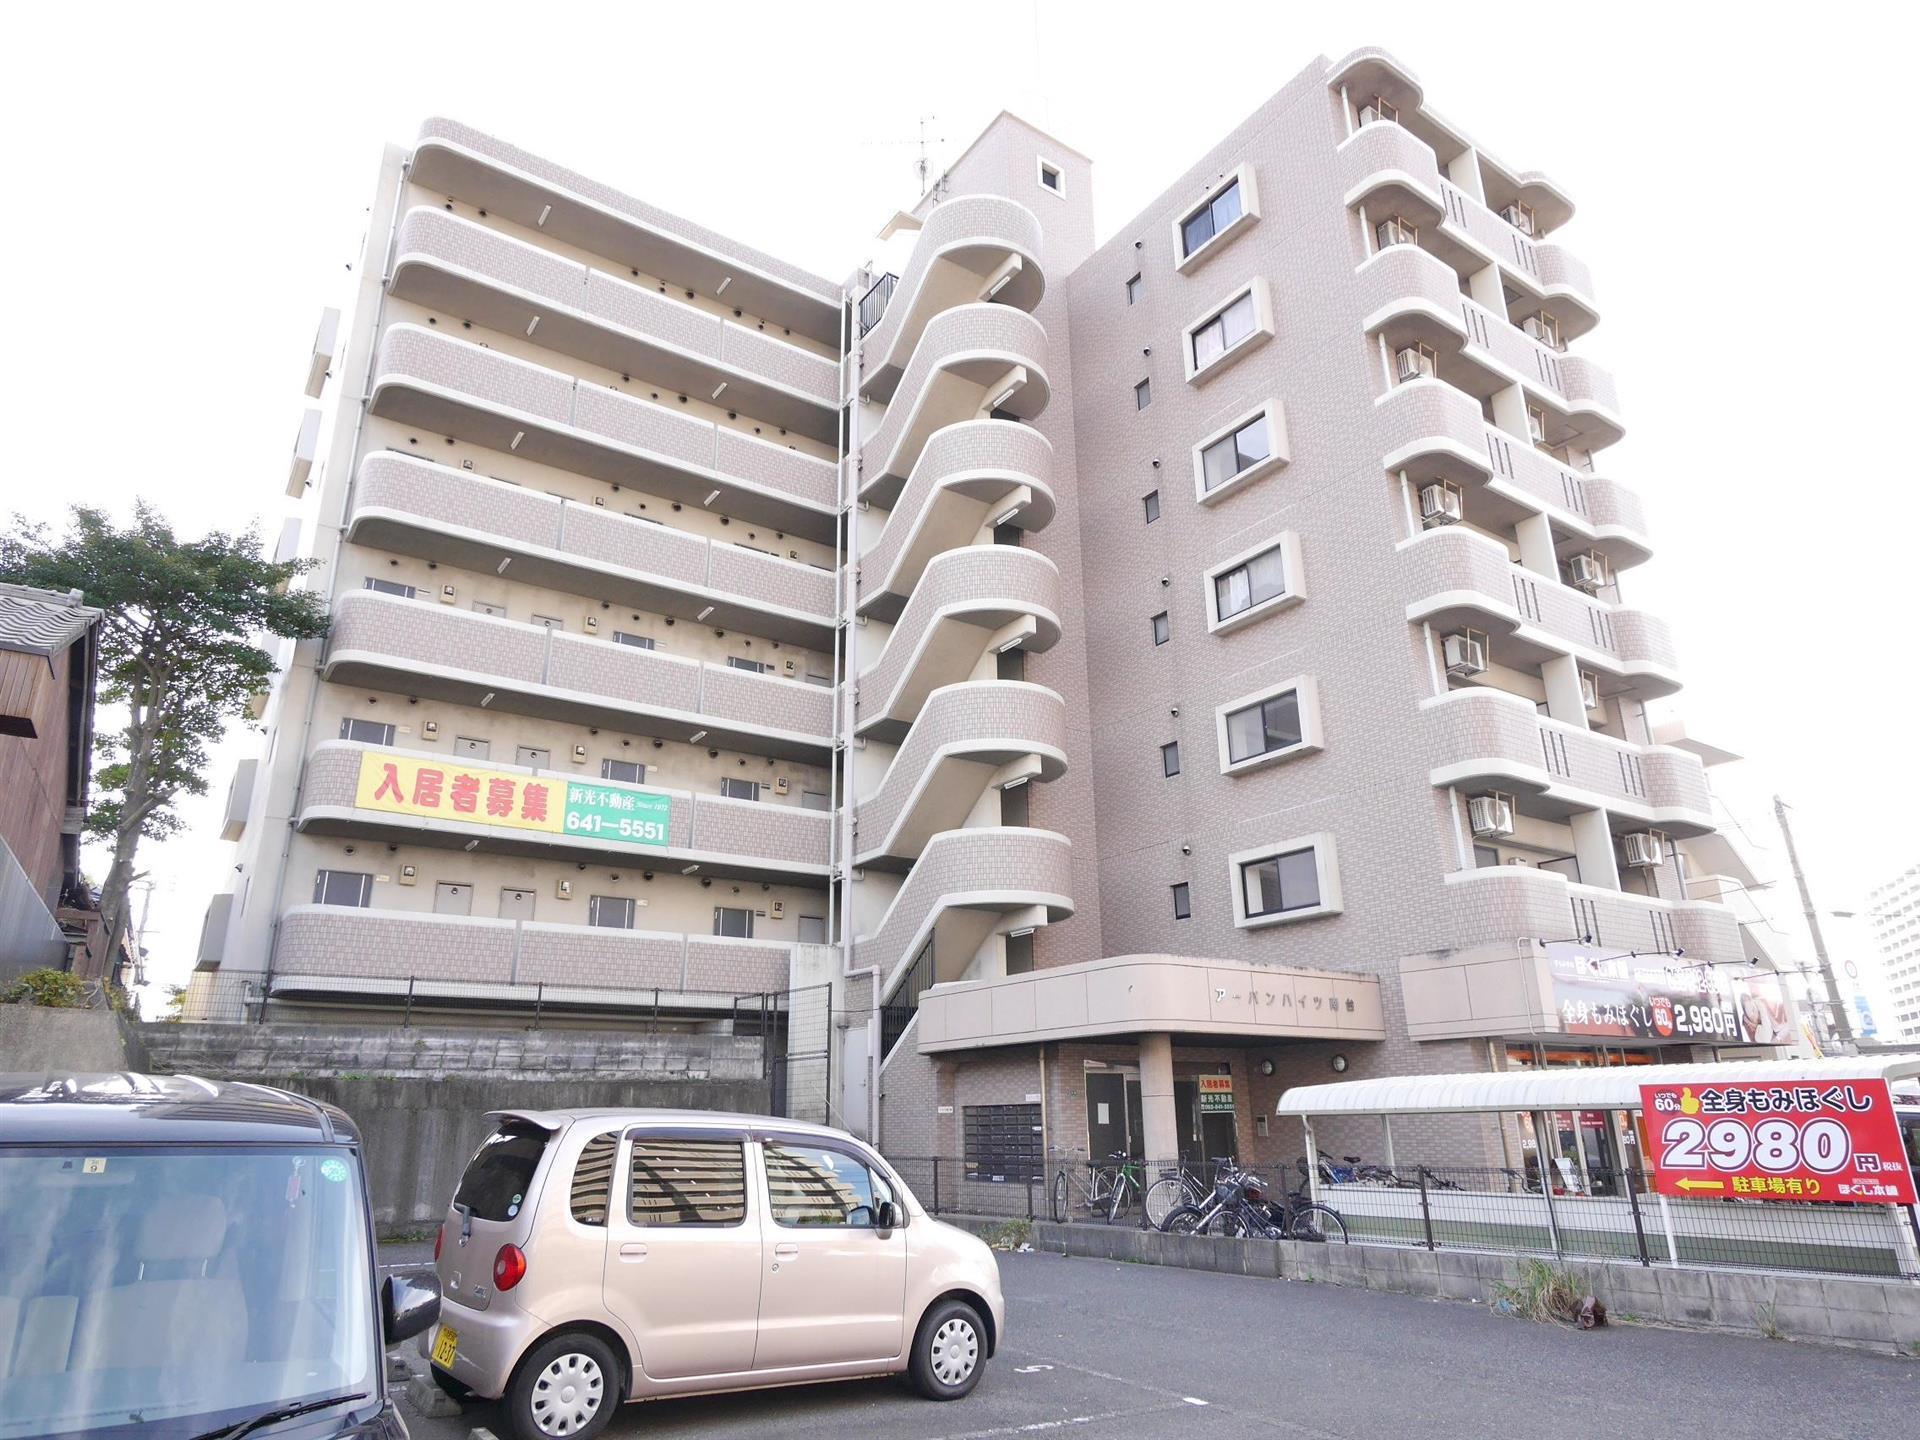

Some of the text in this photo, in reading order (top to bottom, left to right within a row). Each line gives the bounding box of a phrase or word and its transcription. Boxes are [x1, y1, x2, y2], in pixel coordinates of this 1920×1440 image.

[374, 763, 549, 822] 入居者募集
[569, 786, 635, 811] 新光不動産
[1562, 999, 1653, 1027] 全身もみほぐし
[1674, 1004, 1738, 1037] 2,980円
[1654, 1098, 1681, 1111] 60分
[1701, 1086, 1872, 1114] 全身もみほぐし
[1731, 1176, 1820, 1195] 駐車場有り
